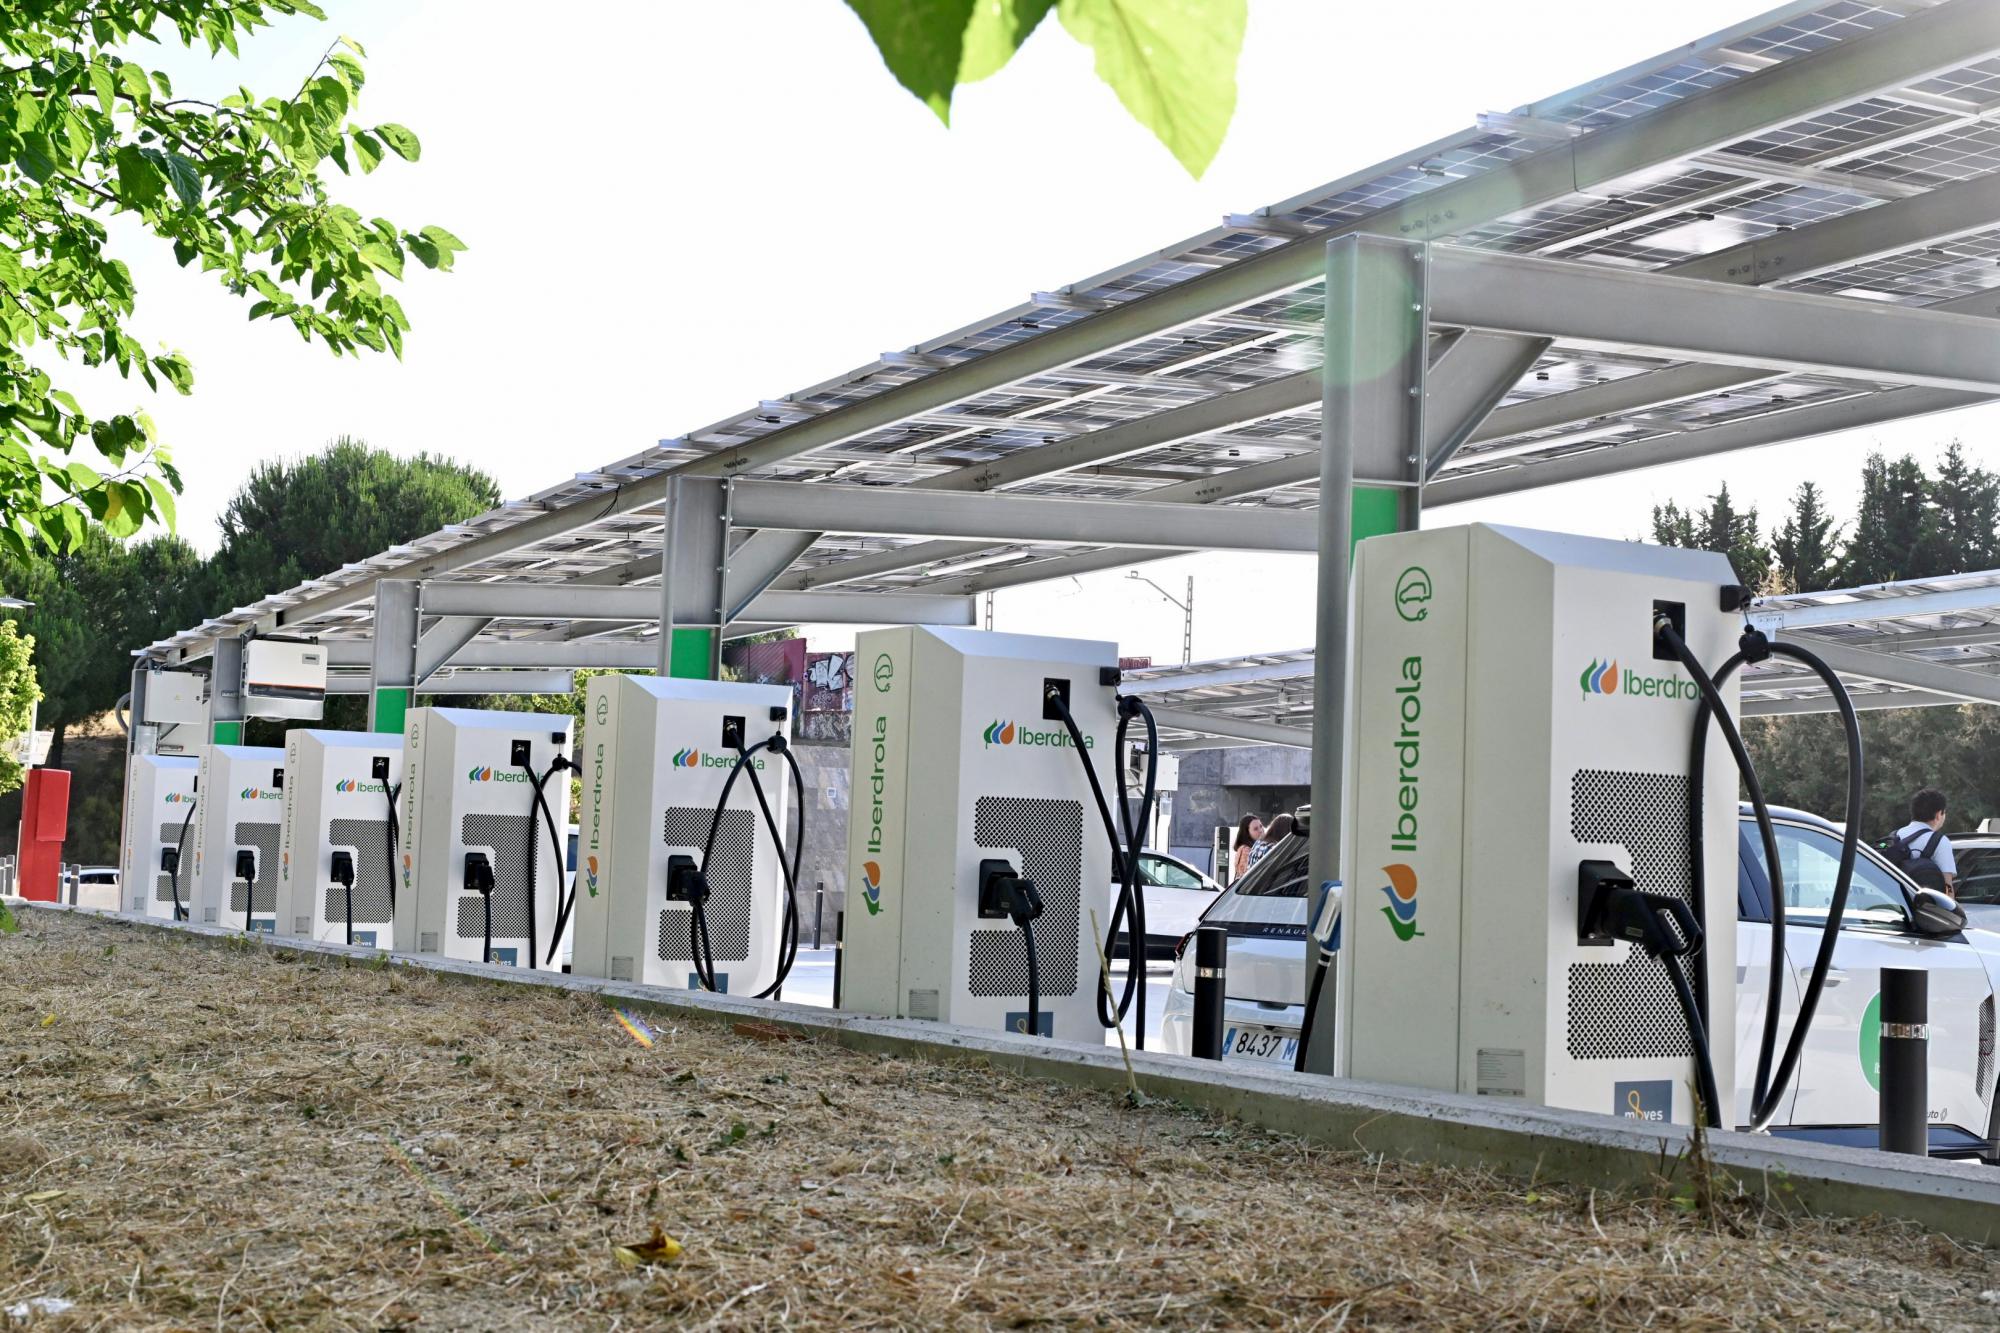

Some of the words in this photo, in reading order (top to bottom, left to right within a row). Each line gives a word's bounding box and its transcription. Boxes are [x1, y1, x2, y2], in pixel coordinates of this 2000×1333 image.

[701, 753, 765, 770] Iberdla
[1018, 726, 1094, 749] Iberdroa
[1391, 656, 1422, 851] Iberdrola
[284, 775, 294, 849] Iberdrola
[405, 763, 416, 850] Iberdrola
[590, 743, 604, 850] Iberdrola
[867, 716, 887, 853] Iberdrola
[1236, 1032, 1282, 1058] 8437
[1282, 1037, 1299, 1061] M
